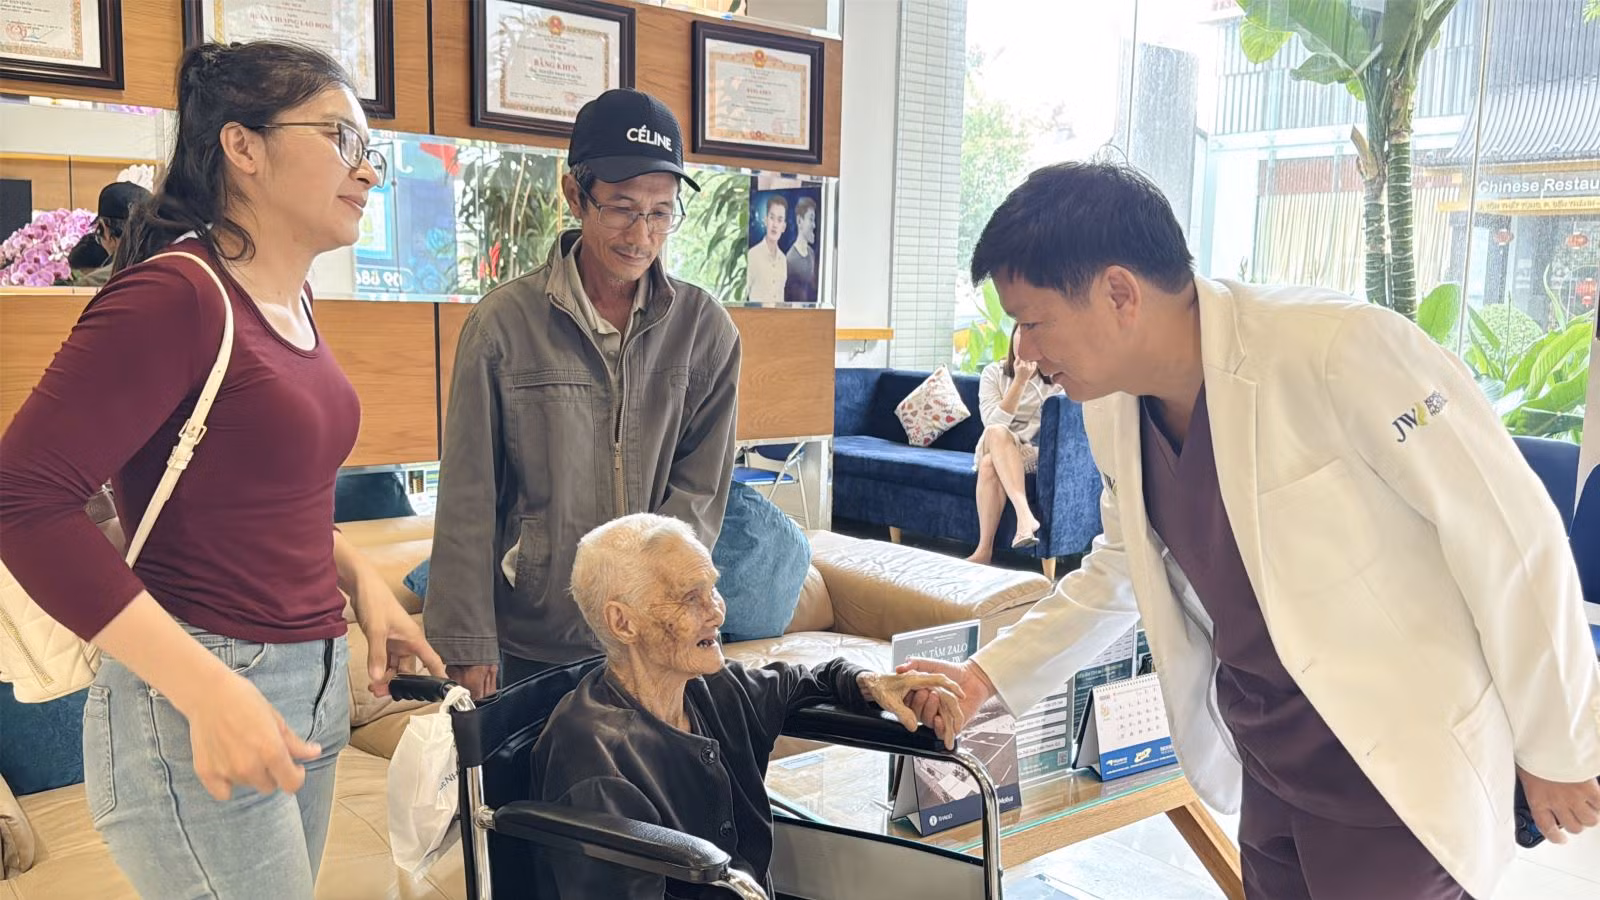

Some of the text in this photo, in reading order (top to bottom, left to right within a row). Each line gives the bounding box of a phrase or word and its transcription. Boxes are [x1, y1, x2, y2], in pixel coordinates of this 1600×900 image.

[626, 124, 672, 152] CÉLINE
[1479, 177, 1600, 193] Chinese Restau
[947, 642, 968, 656] ZALO
